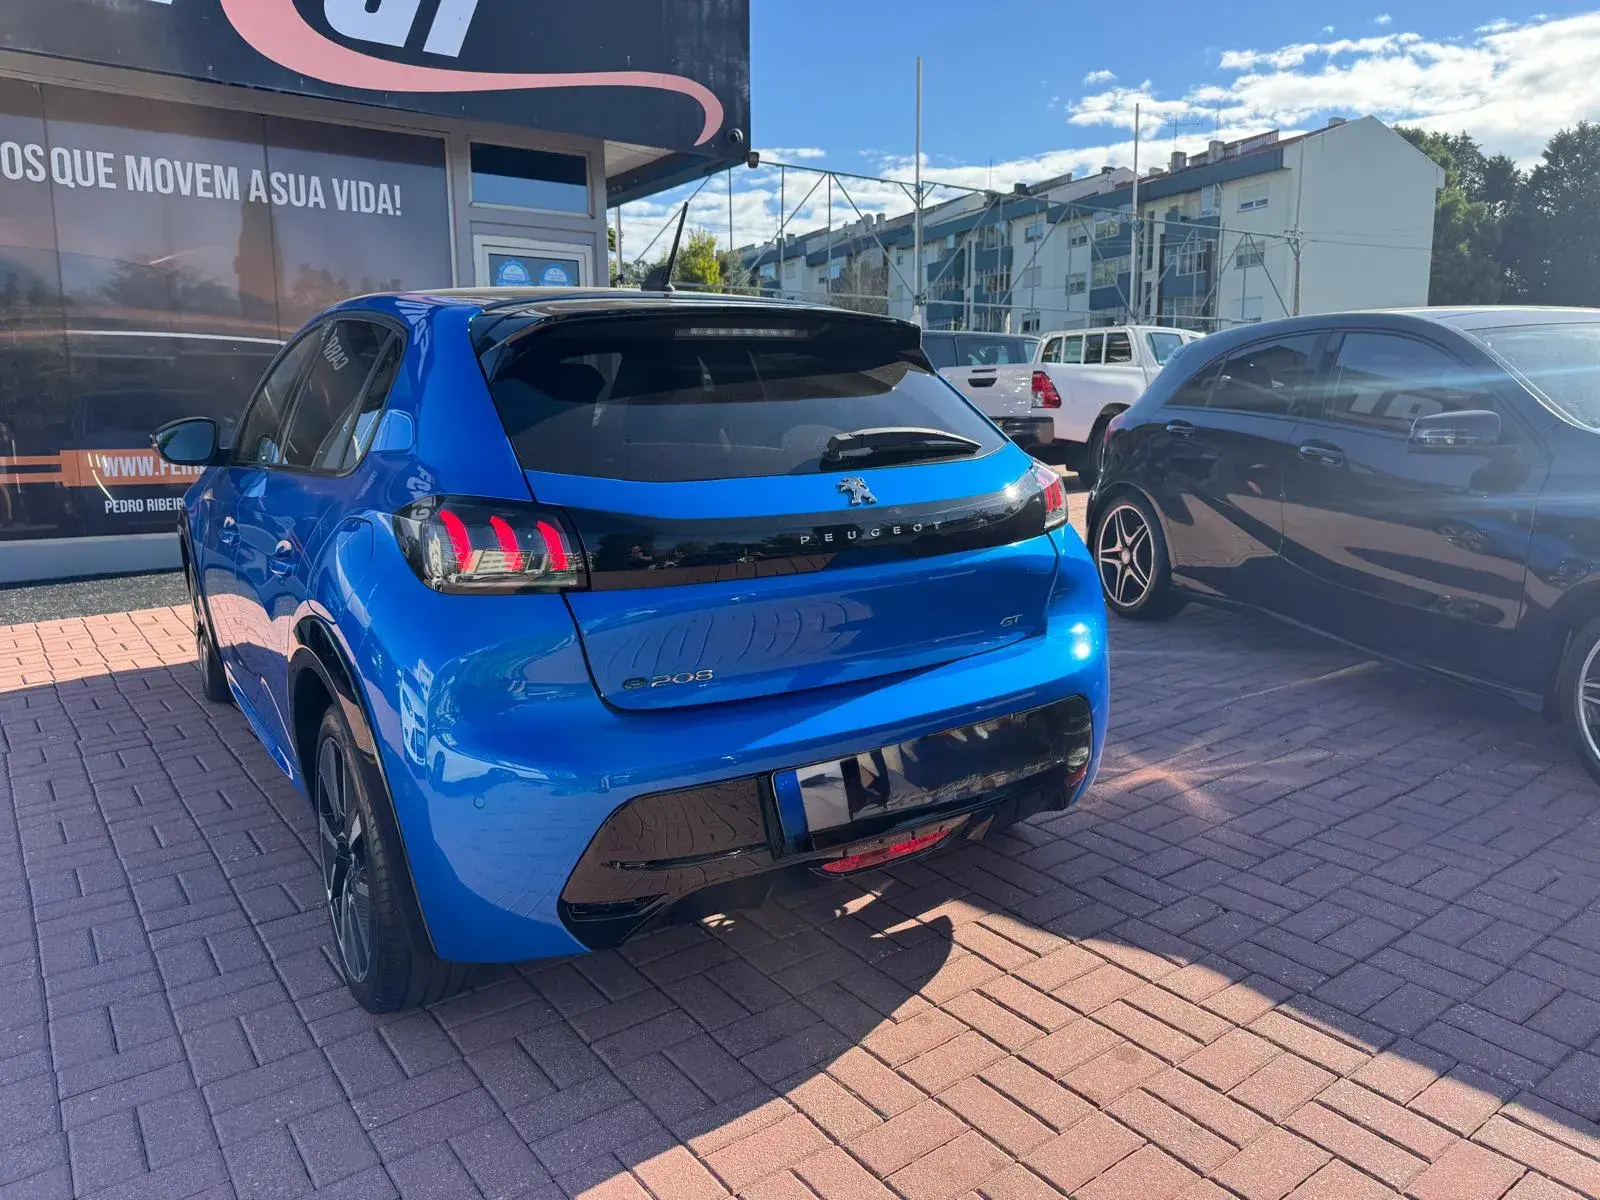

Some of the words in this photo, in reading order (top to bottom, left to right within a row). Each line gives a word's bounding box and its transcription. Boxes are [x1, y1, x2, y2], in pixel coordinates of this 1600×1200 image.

[0, 141, 46, 182] OS
[51, 147, 117, 188] QUE
[125, 154, 240, 200] MOVEM
[249, 168, 268, 203] A
[270, 171, 326, 209] SUA
[332, 177, 401, 216] VIDA!
[105, 499, 144, 513] PEDRO
[800, 521, 941, 545] PEUGEOT
[1000, 613, 1024, 627] GT
